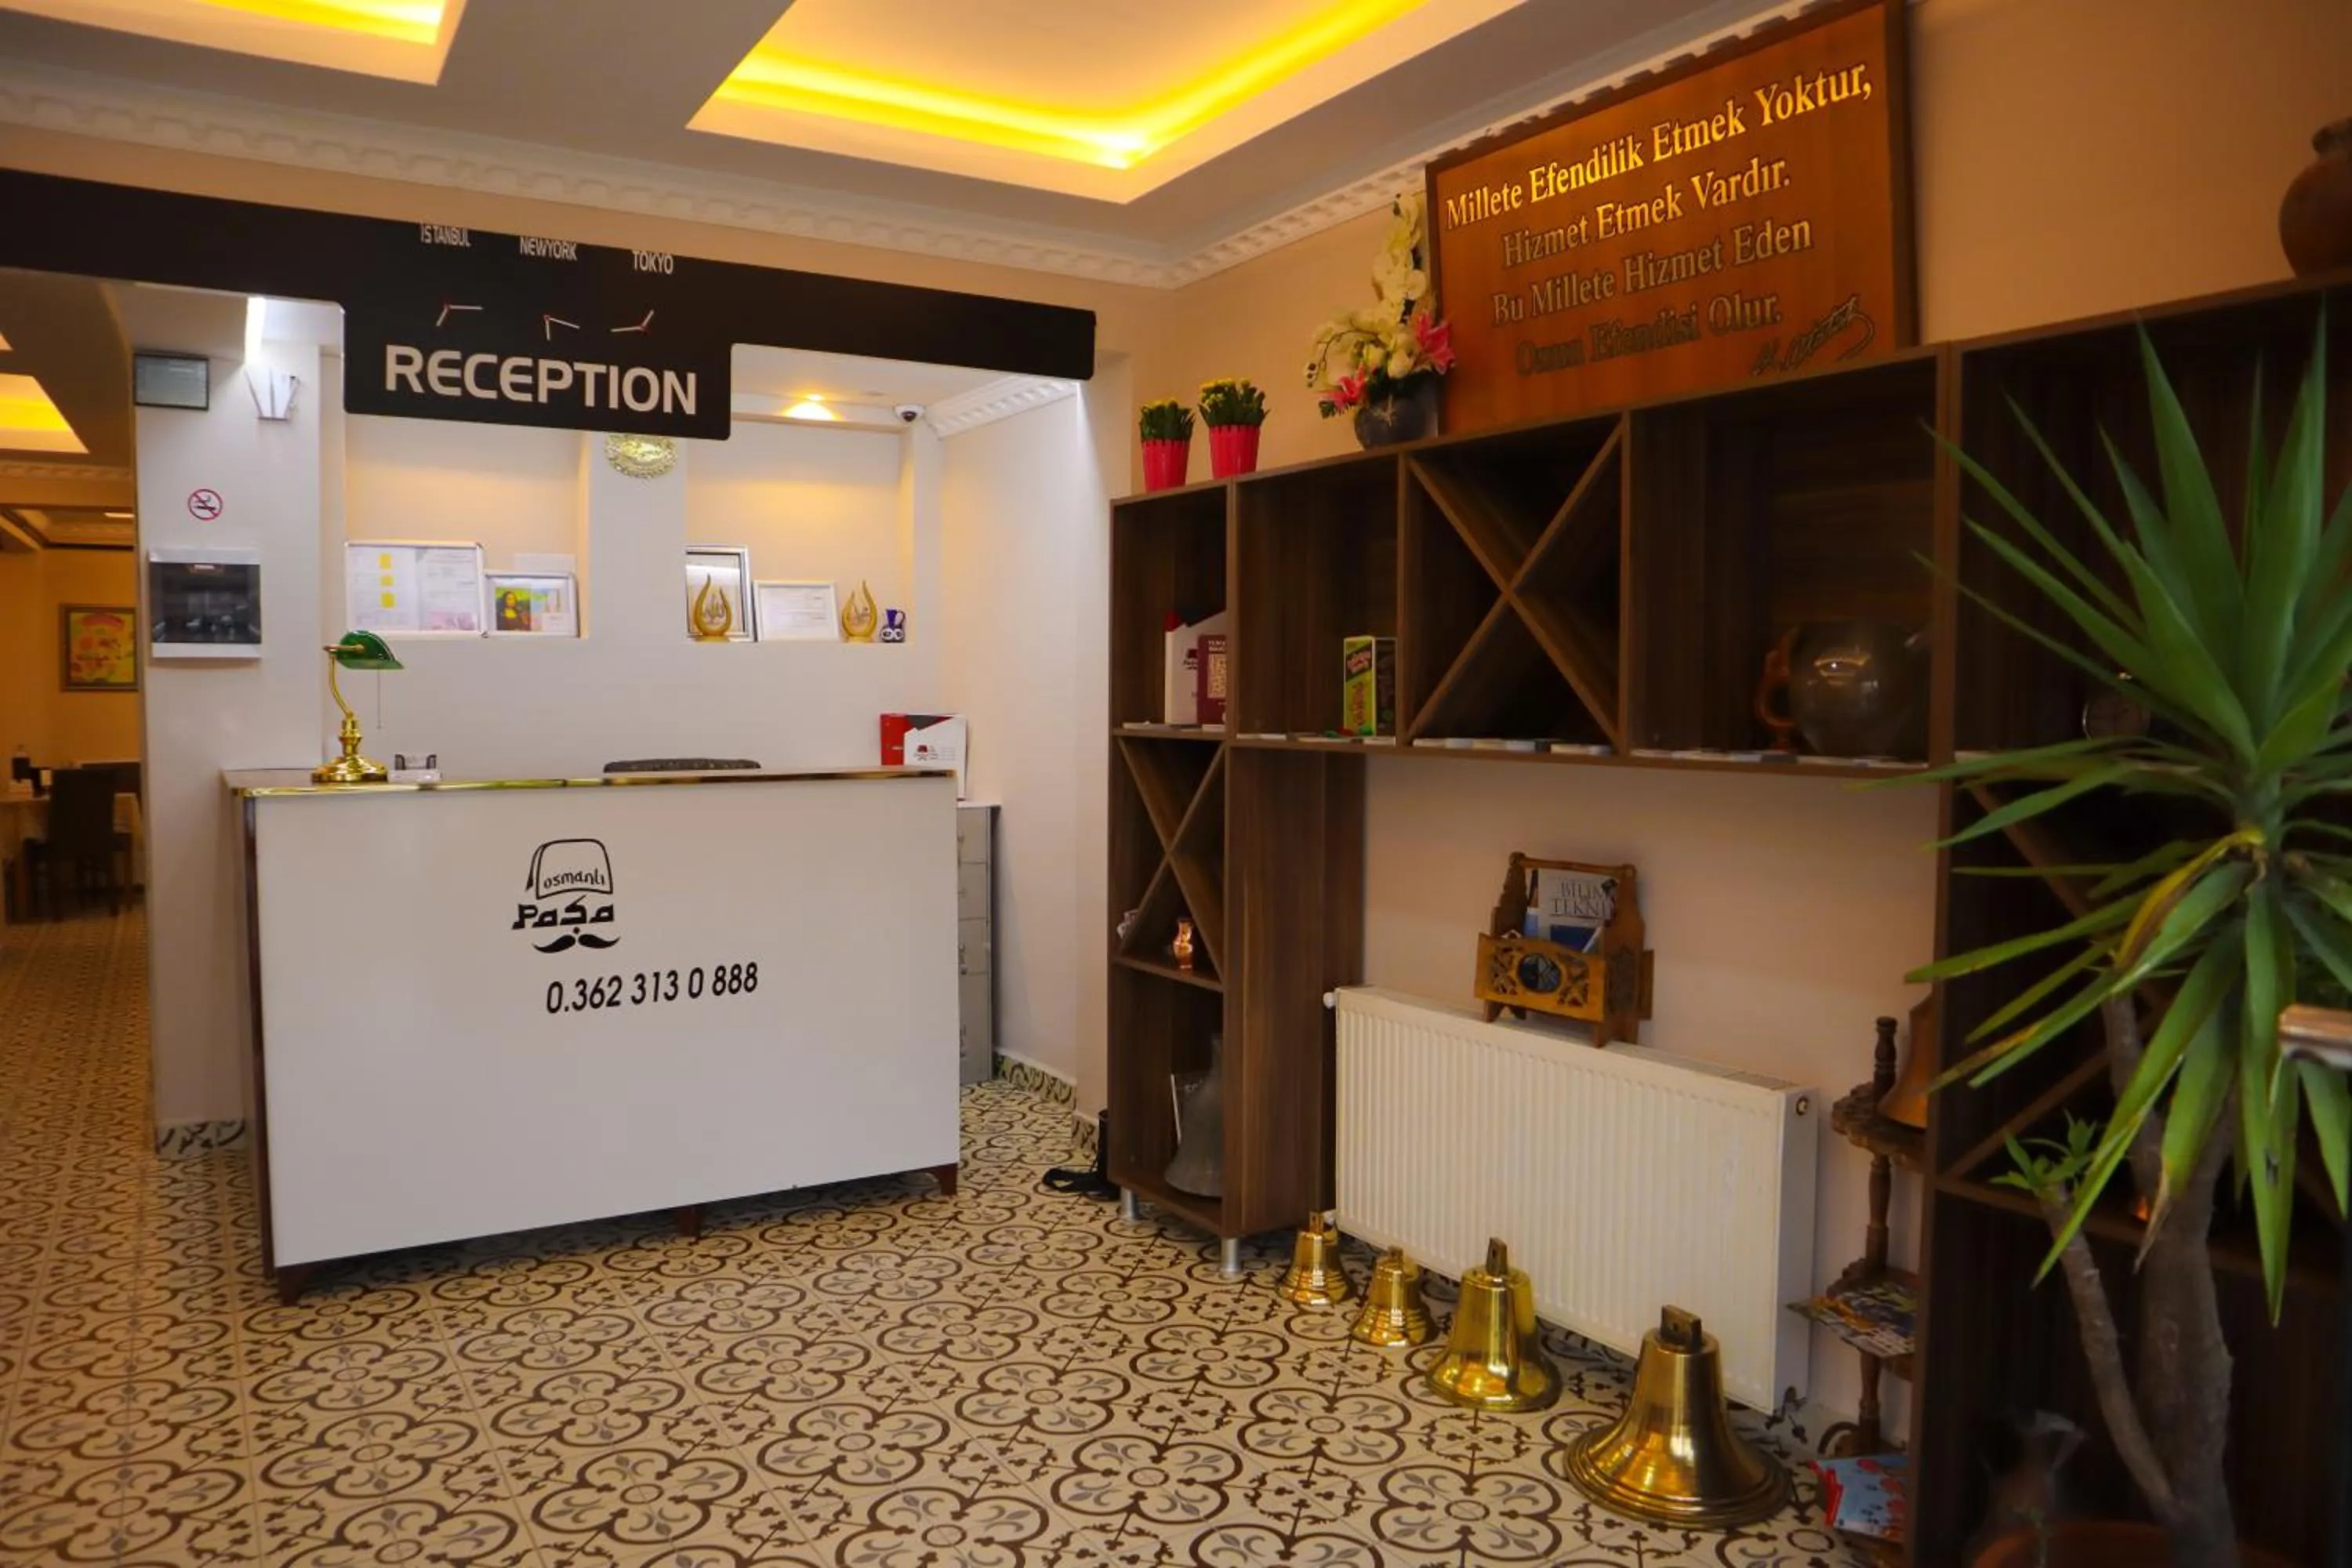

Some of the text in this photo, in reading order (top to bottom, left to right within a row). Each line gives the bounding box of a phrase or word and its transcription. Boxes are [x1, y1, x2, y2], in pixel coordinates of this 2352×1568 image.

[1446, 64, 1872, 230] Millete Efendilik Etmek Yoktur,
[1502, 157, 1791, 267] Hizmet Etmek Vardır.
[631, 249, 675, 275] TOKYO
[1492, 219, 1812, 325] Bu Millete Hizmet Eden
[1708, 292, 1783, 336] Olur.
[385, 343, 698, 416] RECEPTION
[546, 975, 623, 1014] 0.362
[630, 970, 679, 1005] 313
[712, 961, 759, 996] 888
